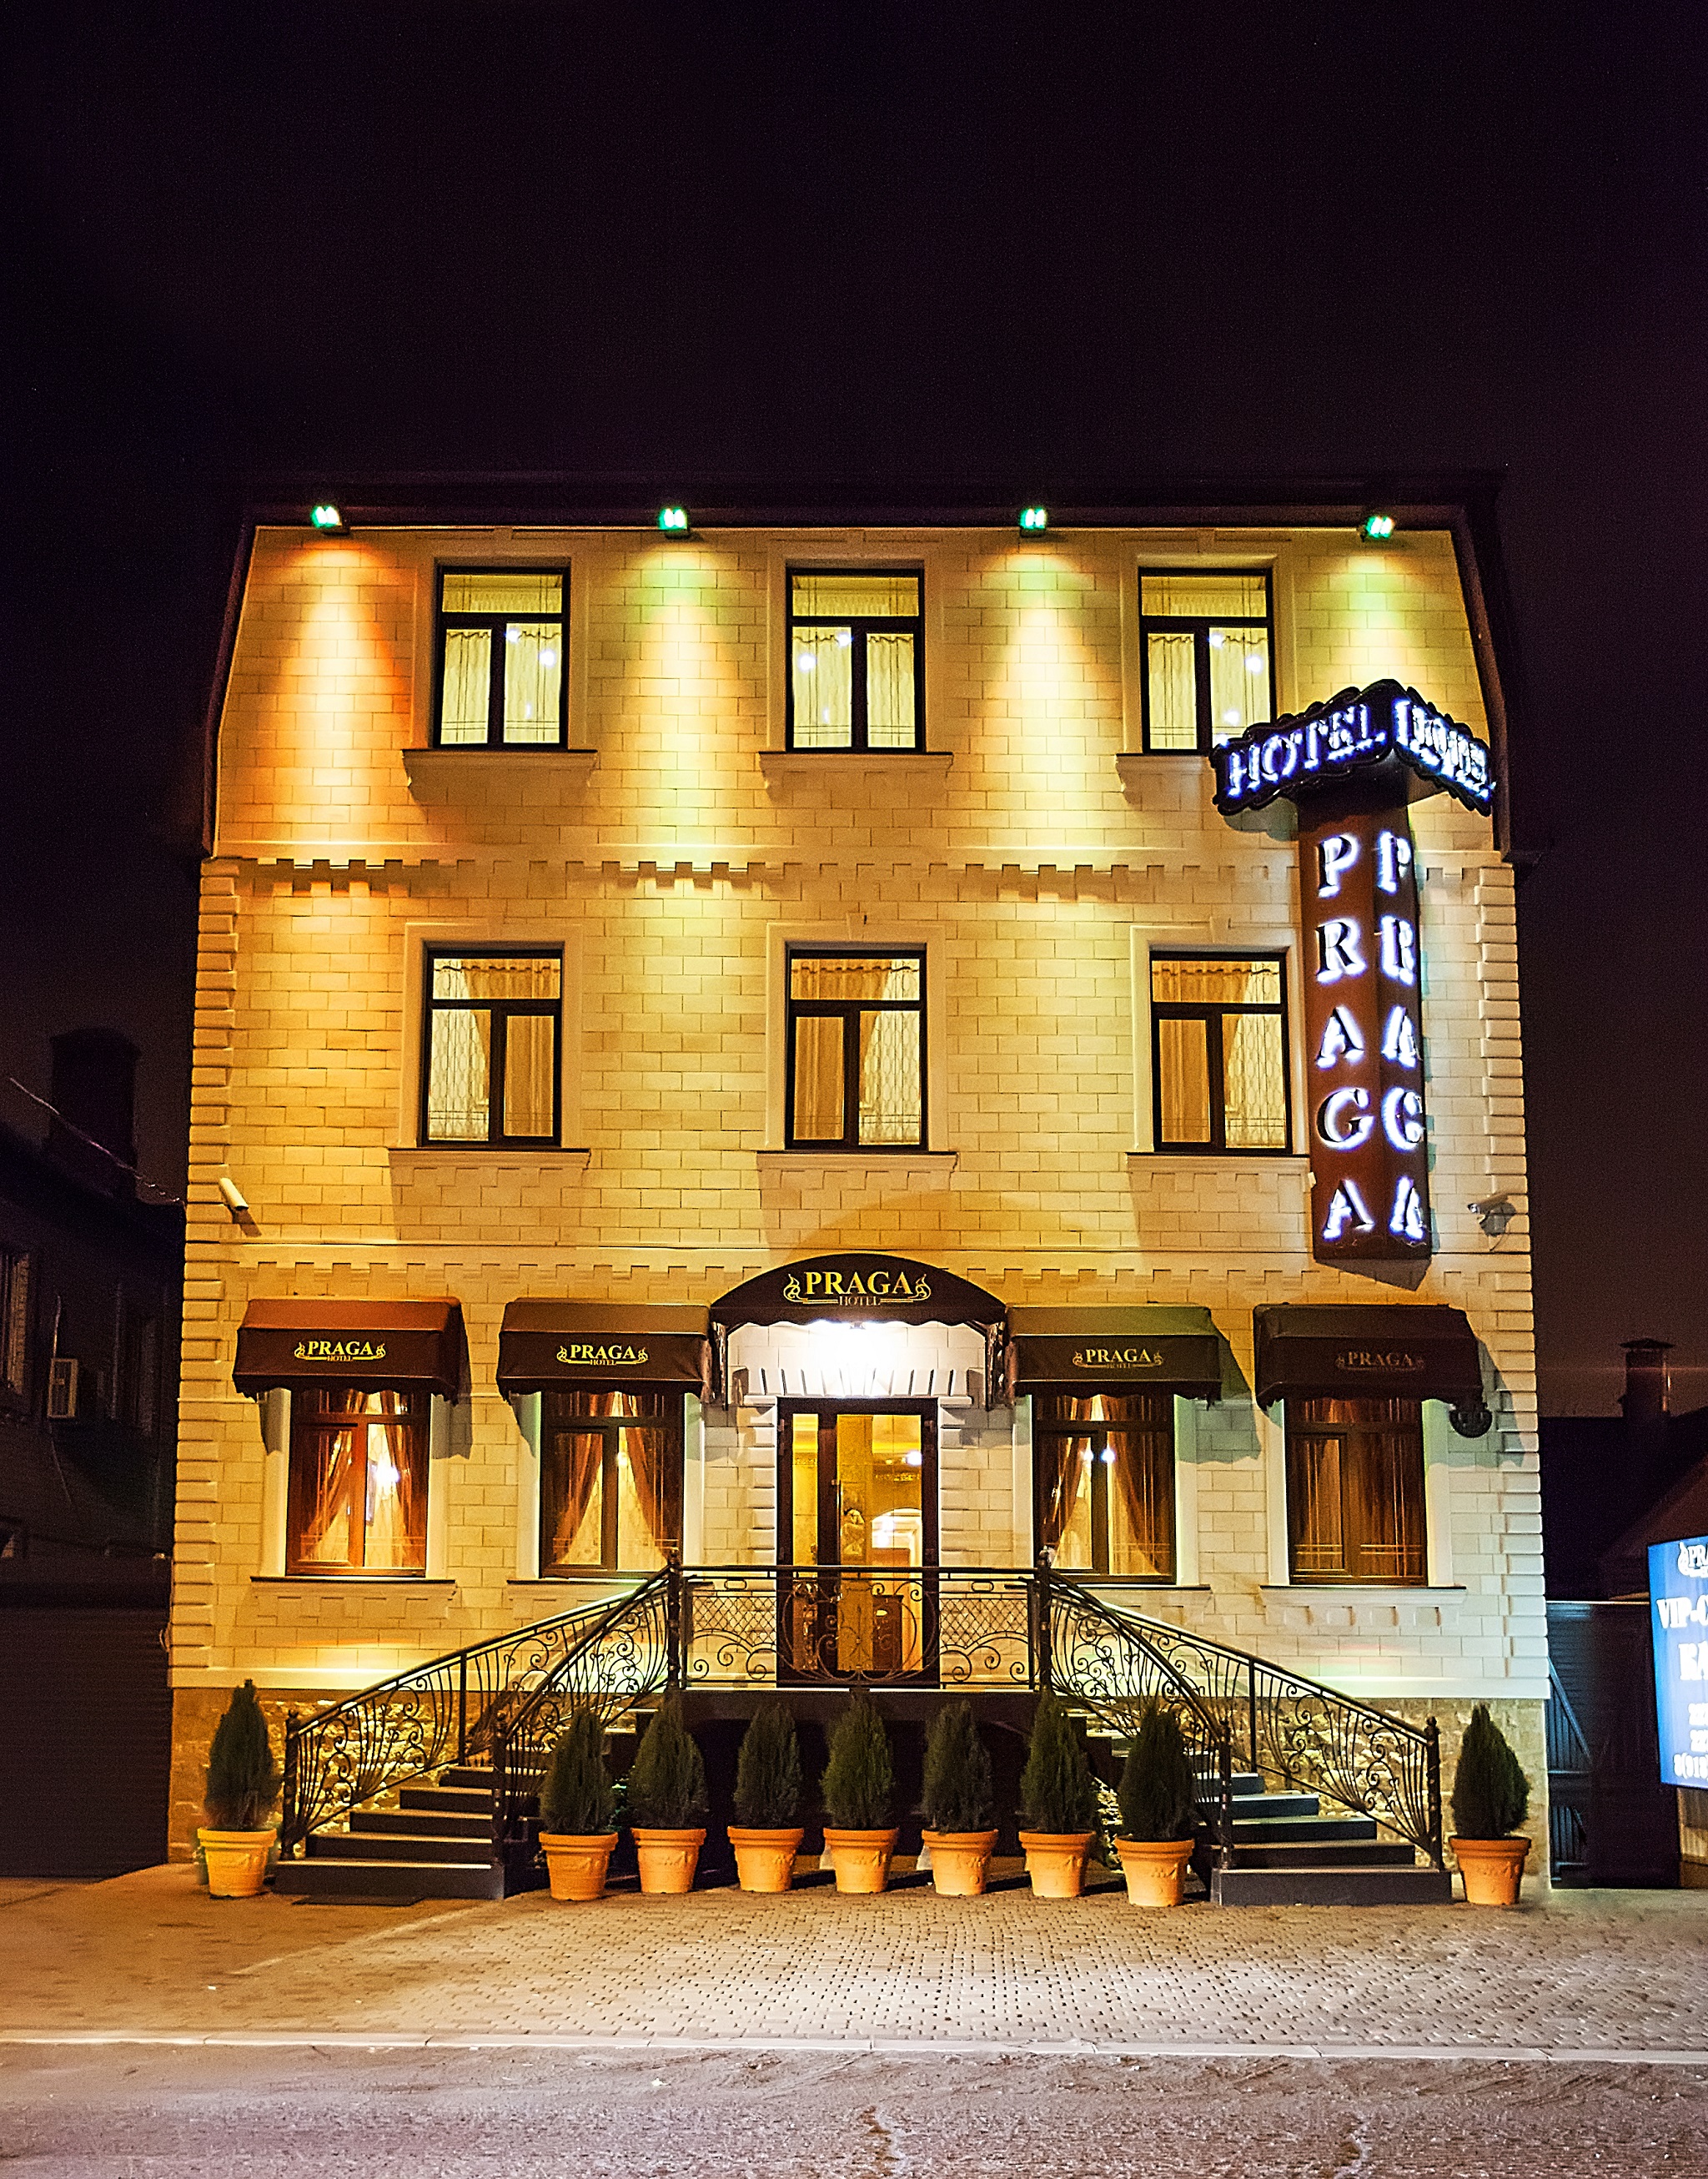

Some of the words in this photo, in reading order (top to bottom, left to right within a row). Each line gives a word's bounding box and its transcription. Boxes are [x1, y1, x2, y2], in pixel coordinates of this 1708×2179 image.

[1227, 703, 1386, 797] HOTEL
[1315, 833, 1375, 1240] PRAGA
[805, 1271, 913, 1295] PRAGA
[839, 1295, 881, 1306] HOTEL
[307, 1341, 374, 1355] PRAGA
[570, 1344, 635, 1359] PRAGA
[1086, 1348, 1151, 1362] PRAGA
[1348, 1351, 1413, 1366] PRAGA
